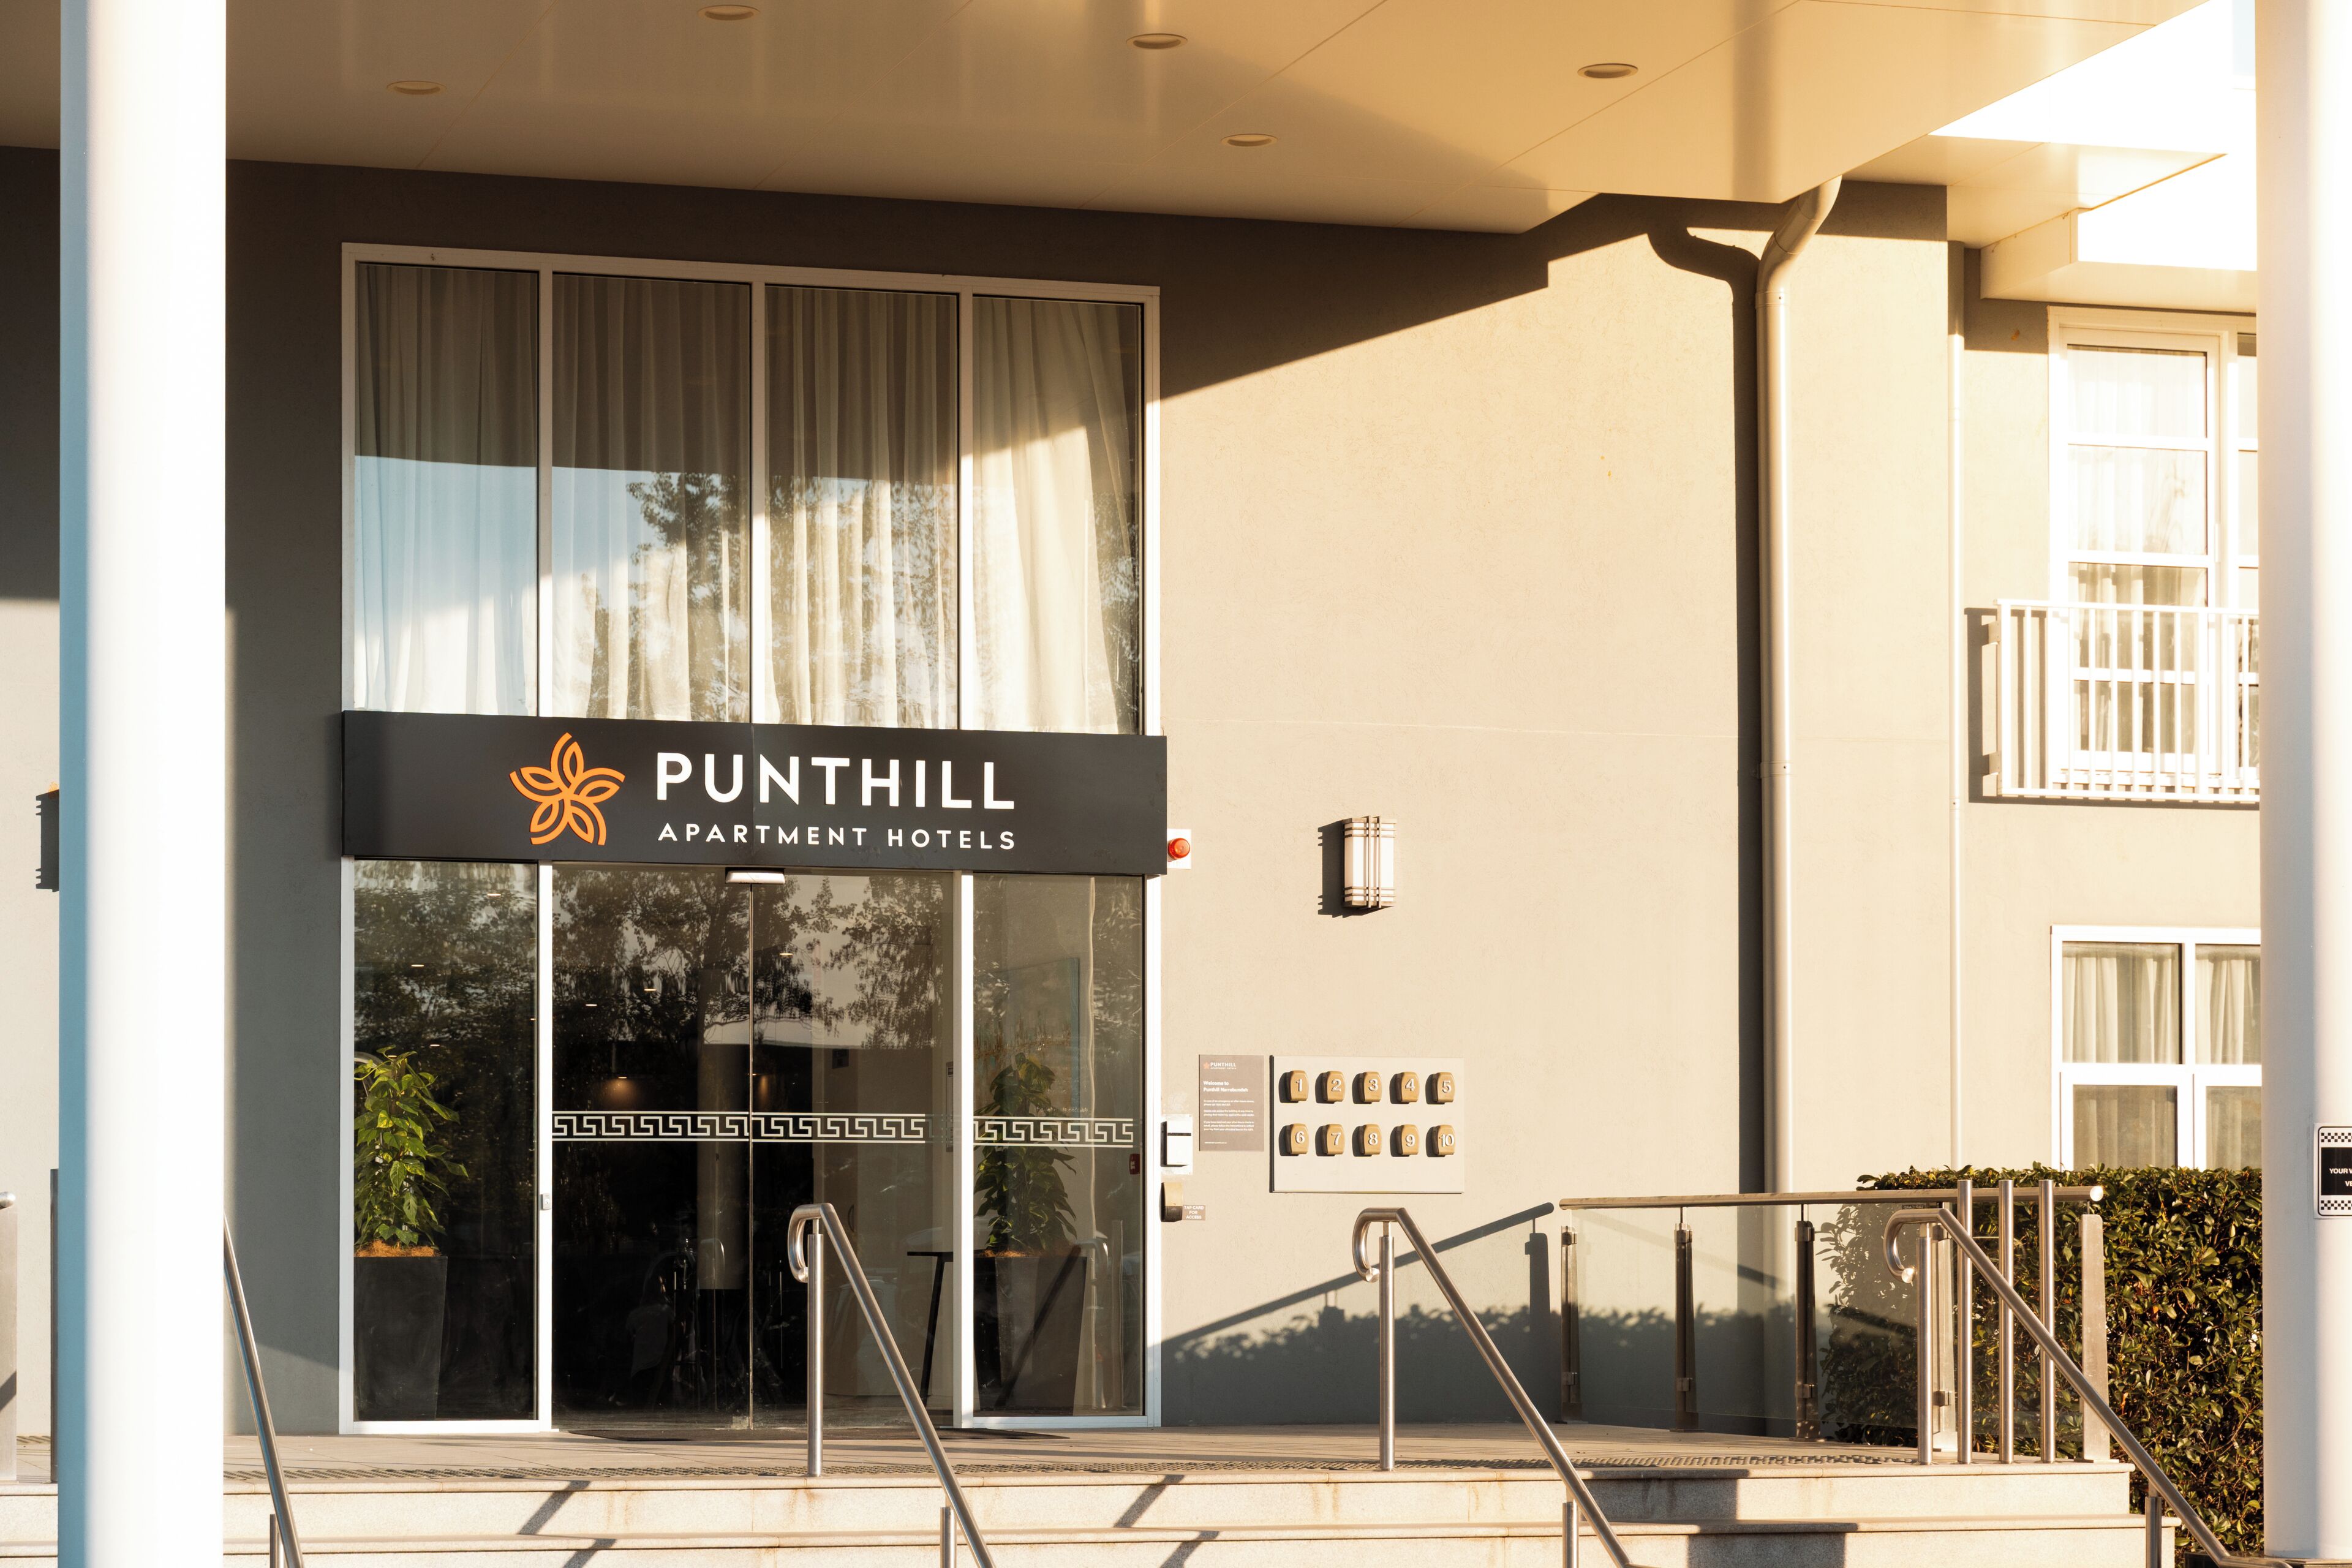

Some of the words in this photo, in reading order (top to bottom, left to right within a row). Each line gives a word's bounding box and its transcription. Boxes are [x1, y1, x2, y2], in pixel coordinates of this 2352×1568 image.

[657, 752, 1015, 810] PUNTHILL
[657, 823, 867, 846] APARTMENT
[888, 829, 1015, 850] HOTELS
[1295, 1078, 1303, 1091] 1
[1331, 1079, 1341, 1092] 2
[1368, 1079, 1378, 1091] 3
[1405, 1078, 1415, 1092] 4
[1442, 1080, 1452, 1093] 5
[1295, 1131, 1305, 1144] 6
[1331, 1132, 1341, 1145] 7
[1368, 1133, 1378, 1145] 8
[1405, 1134, 1415, 1147] 9
[1441, 1134, 1455, 1147] 10
